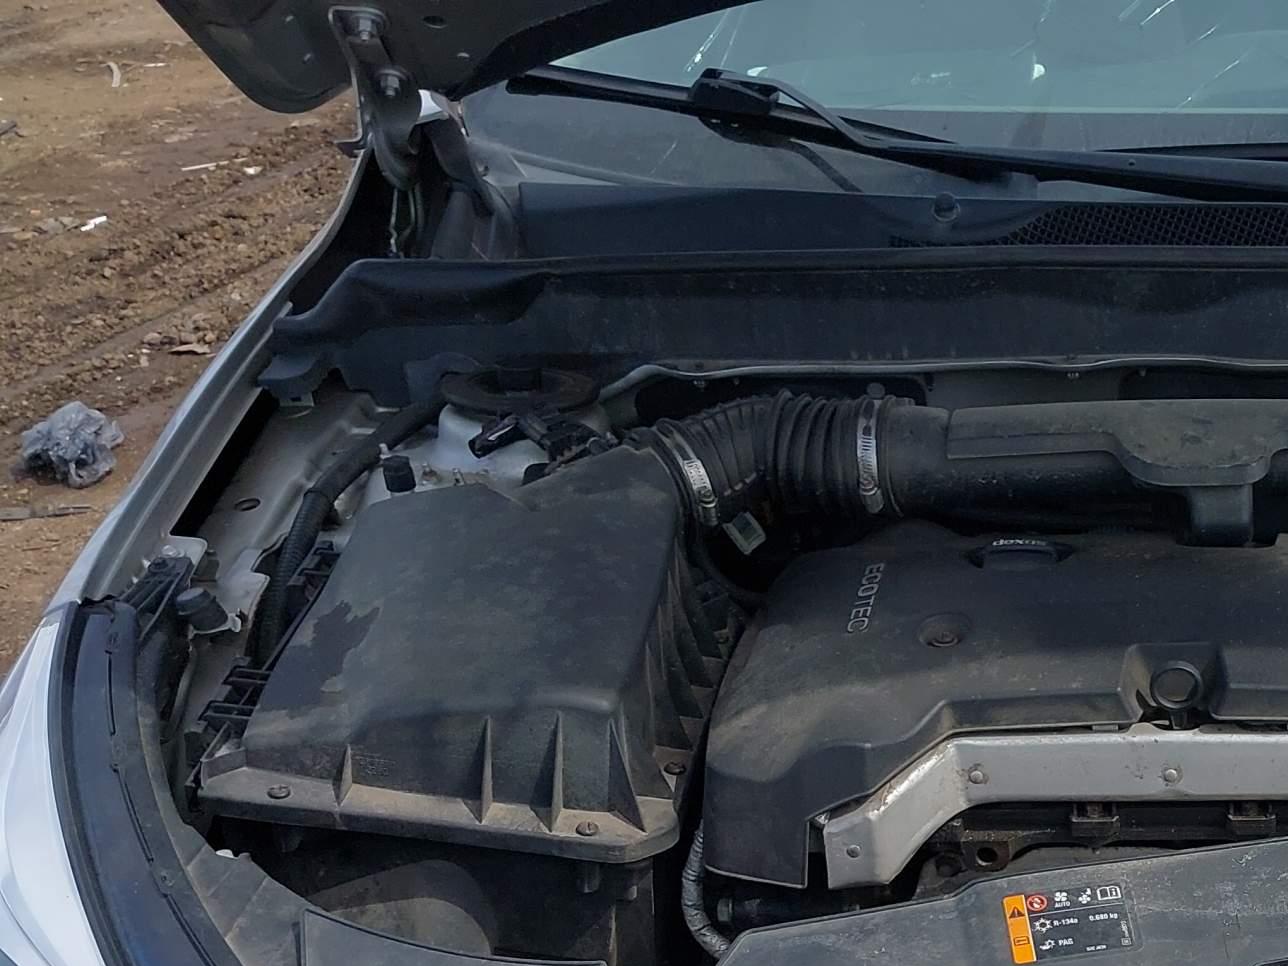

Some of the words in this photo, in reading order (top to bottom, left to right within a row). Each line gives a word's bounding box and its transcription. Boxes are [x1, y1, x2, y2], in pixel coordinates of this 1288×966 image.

[846, 561, 885, 634] ECOTEC
[1052, 918, 1079, 926] R-134a
[1109, 912, 1119, 920] kg
[1058, 938, 1074, 946] PAG
